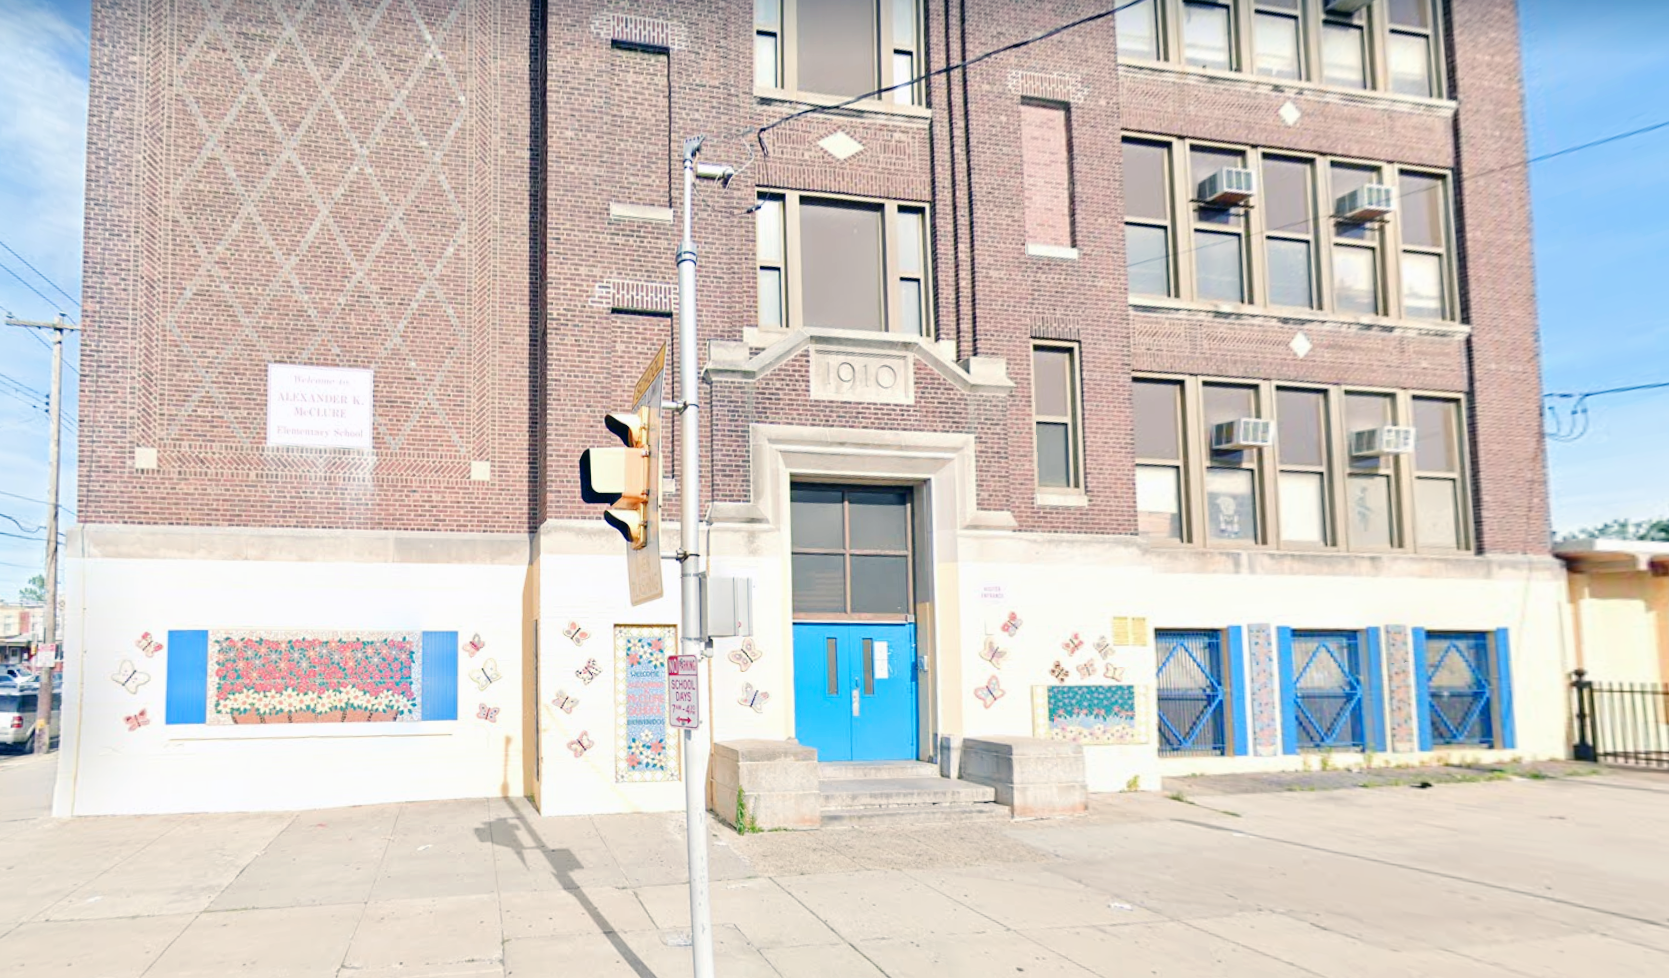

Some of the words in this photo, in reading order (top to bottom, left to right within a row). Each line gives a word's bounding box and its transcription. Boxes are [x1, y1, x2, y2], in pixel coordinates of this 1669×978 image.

[294, 375, 335, 385] Welcome
[823, 361, 897, 391] 1910
[278, 392, 348, 404] ALEXANDER
[353, 395, 365, 407] K.
[294, 406, 346, 418] McCLURE
[277, 426, 330, 438] Elementary
[333, 429, 363, 438] School
[669, 659, 678, 673] NO
[671, 679, 695, 690] SCHOOL
[676, 691, 692, 702] DAYS
